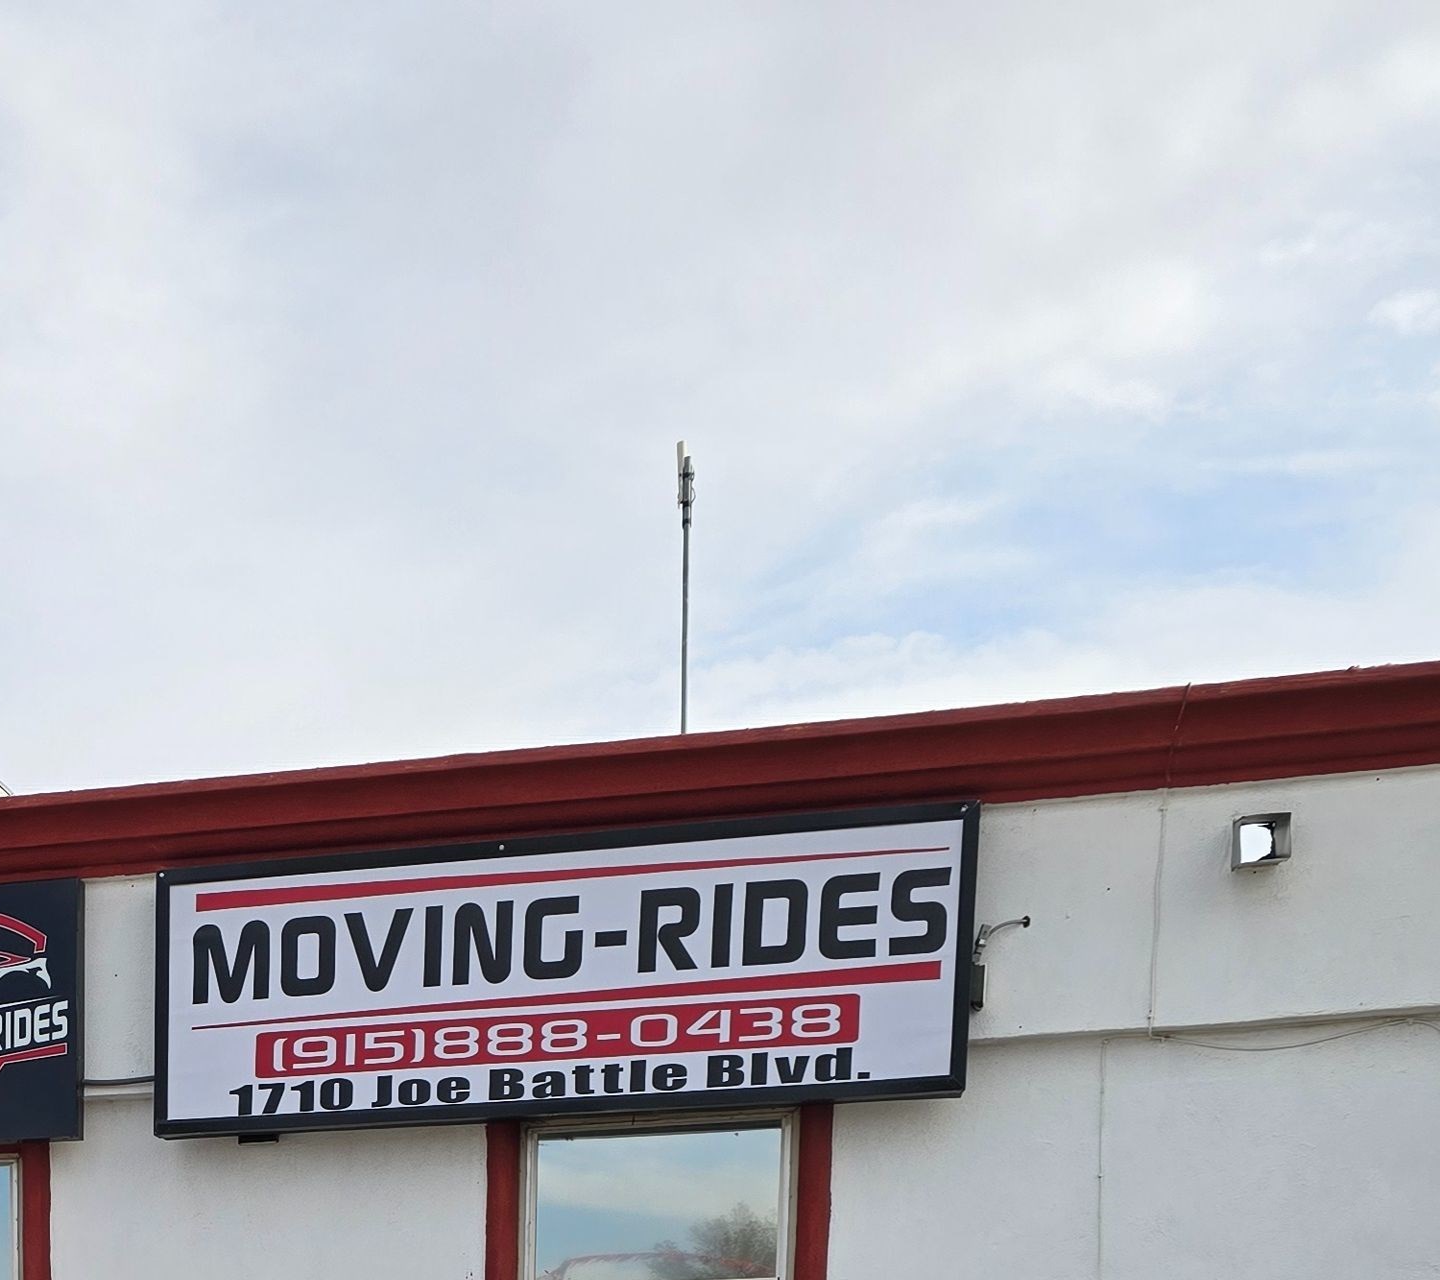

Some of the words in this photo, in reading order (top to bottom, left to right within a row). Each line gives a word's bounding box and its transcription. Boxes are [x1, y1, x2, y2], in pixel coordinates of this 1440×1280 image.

[192, 866, 953, 1004] MOVING-RIDES
[272, 1003, 841, 1072] (915)888-0438
[228, 1076, 354, 1117] 1710
[370, 1074, 471, 1109] Joe
[488, 1059, 688, 1101] Battle
[706, 1046, 871, 1089] Blvd.
